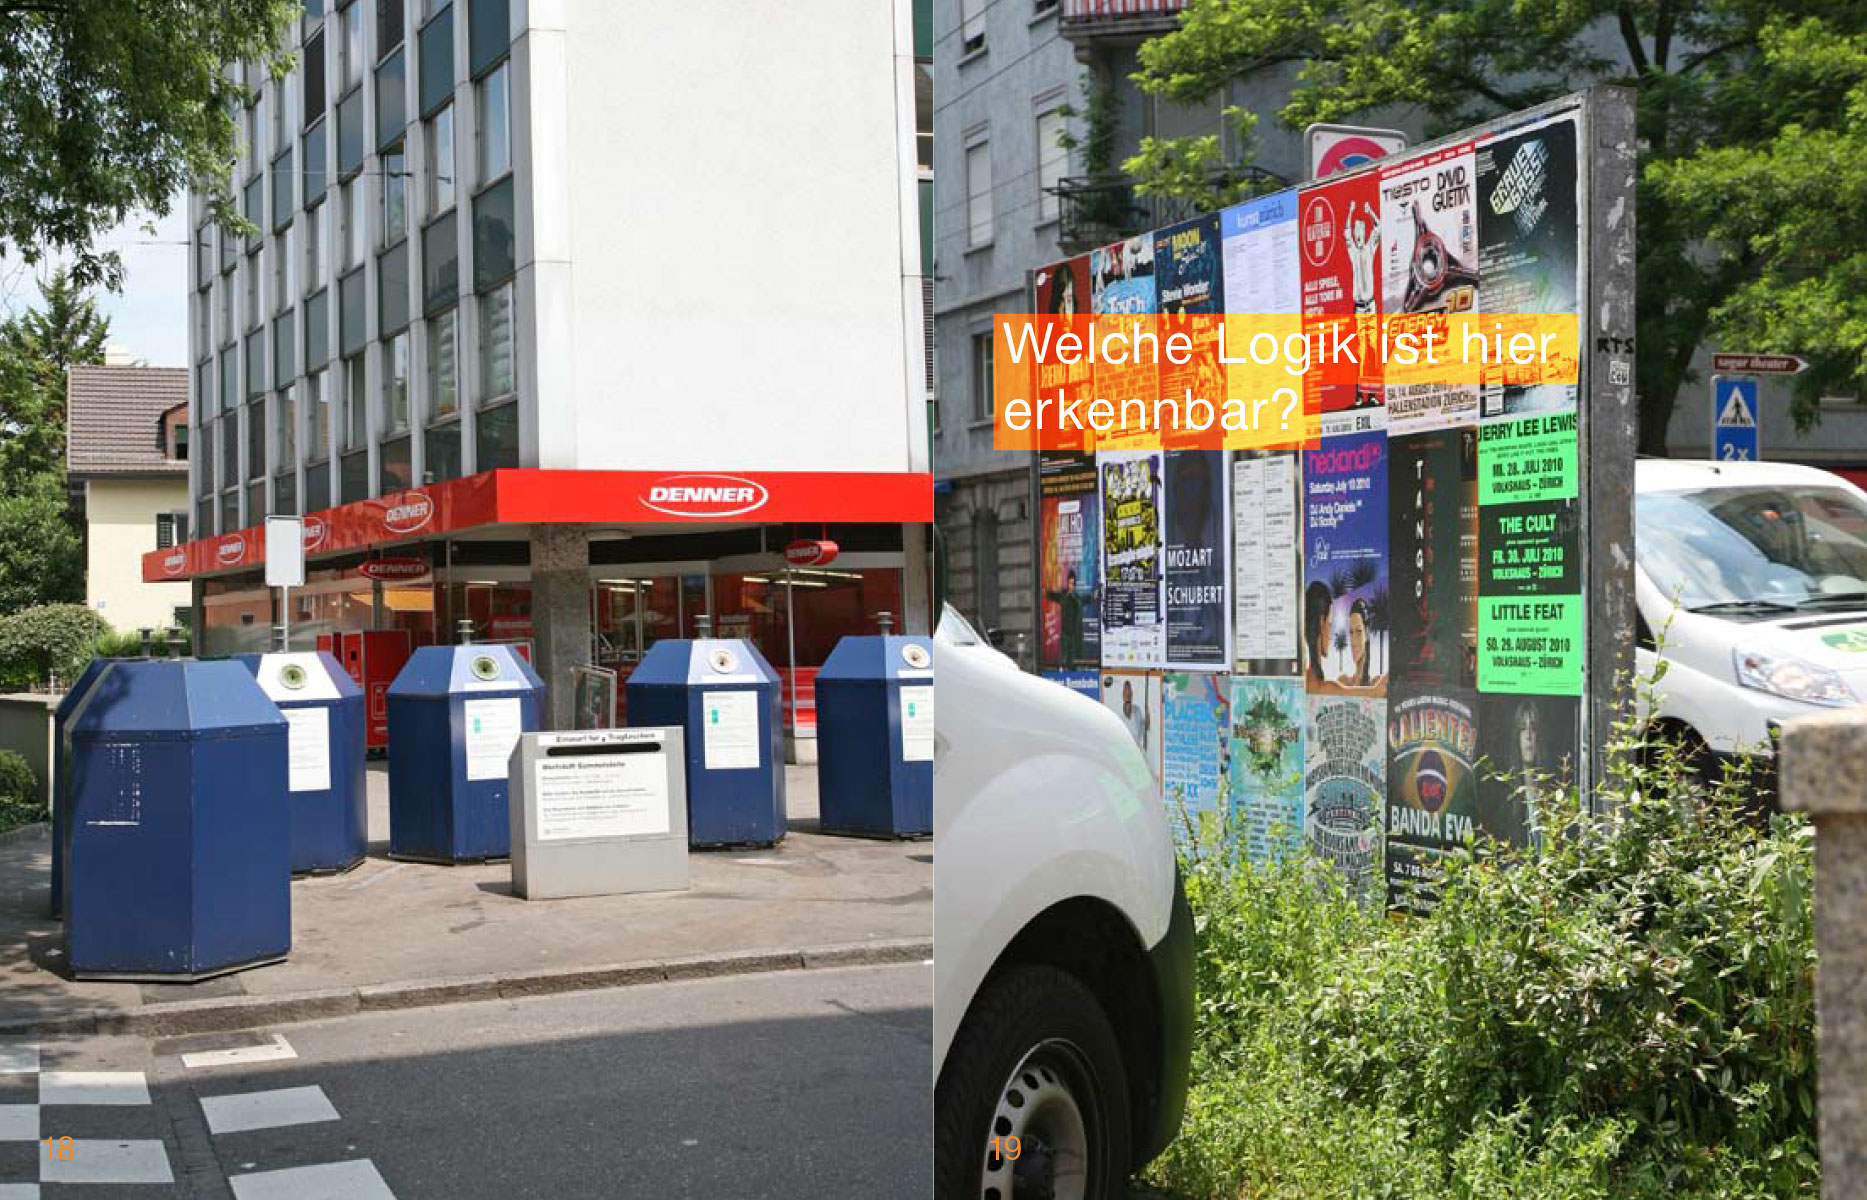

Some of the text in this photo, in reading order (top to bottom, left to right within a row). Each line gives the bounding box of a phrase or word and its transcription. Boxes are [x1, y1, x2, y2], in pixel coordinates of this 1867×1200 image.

[1478, 413, 1577, 442] JERRY LEE LEWIS
[1522, 460, 1540, 475] JULI
[1542, 457, 1563, 472] 2010
[650, 487, 755, 503] DENNER
[386, 501, 428, 523] DENNER
[1499, 513, 1556, 535] THE CULT
[1168, 548, 1214, 567] MOZART
[1522, 548, 1540, 563] JULI
[1542, 546, 1563, 561] 2010
[369, 563, 425, 574] DENNER
[1168, 585, 1223, 605] SCHUBERT
[1492, 603, 1564, 620] LITTLE FEAT
[1515, 637, 1546, 652] AUGUST
[1549, 638, 1570, 652] 2010
[1391, 805, 1475, 843] BANDA EVA
